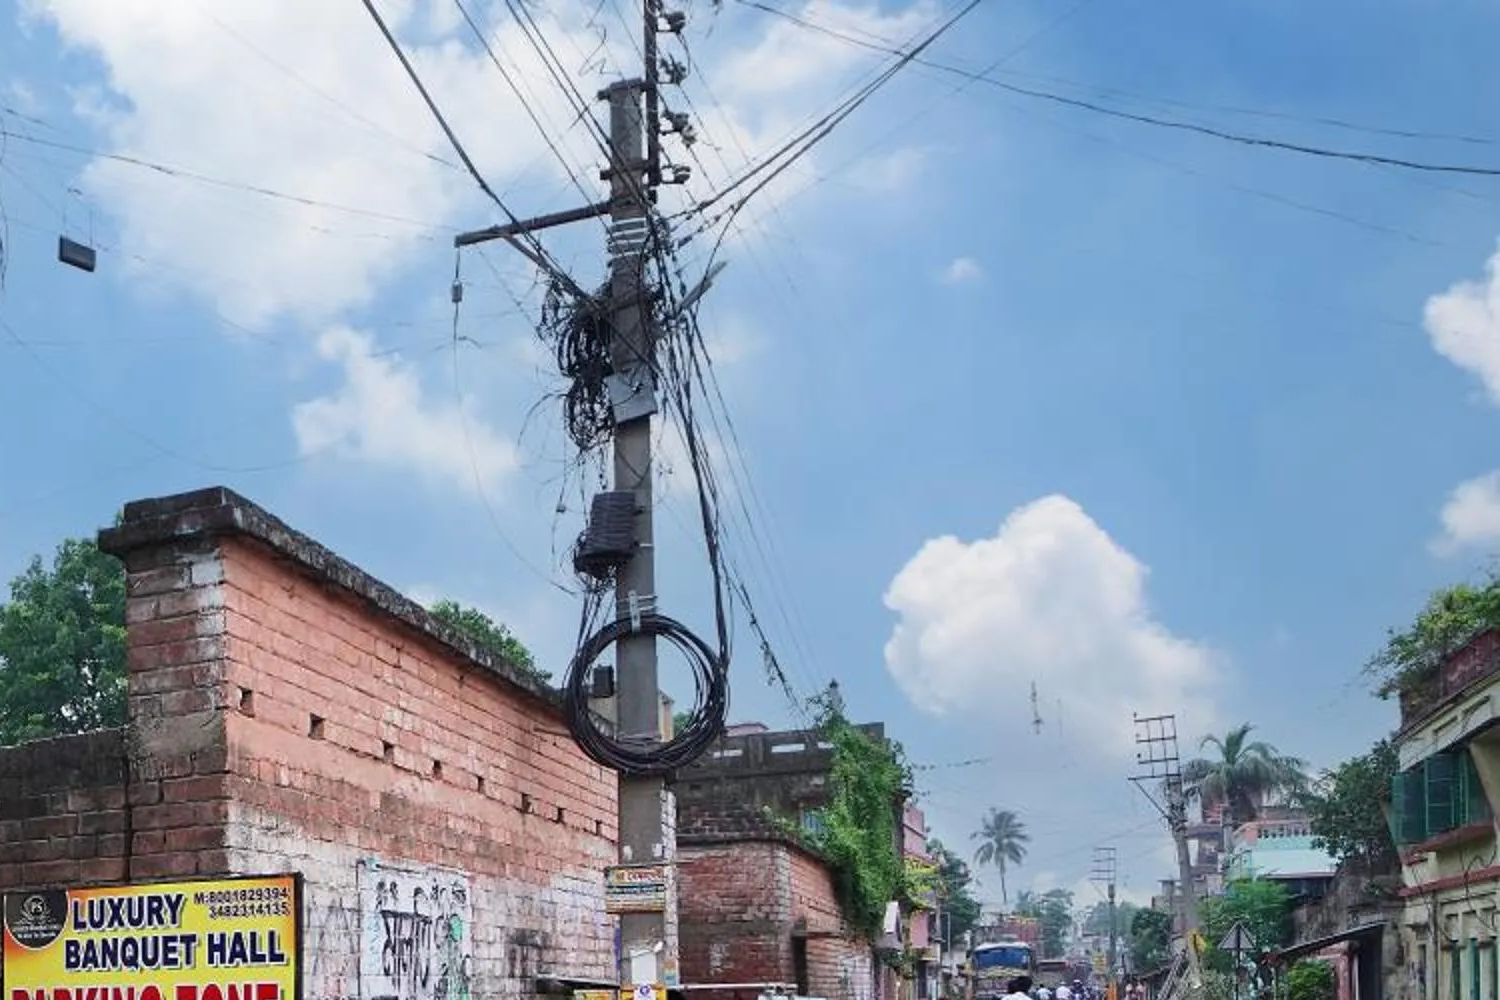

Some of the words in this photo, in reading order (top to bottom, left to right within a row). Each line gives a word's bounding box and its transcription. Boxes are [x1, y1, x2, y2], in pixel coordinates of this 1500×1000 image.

[73, 894, 184, 930] LUXURY
[65, 934, 197, 970] BANQUET
[207, 930, 285, 965] HALL
